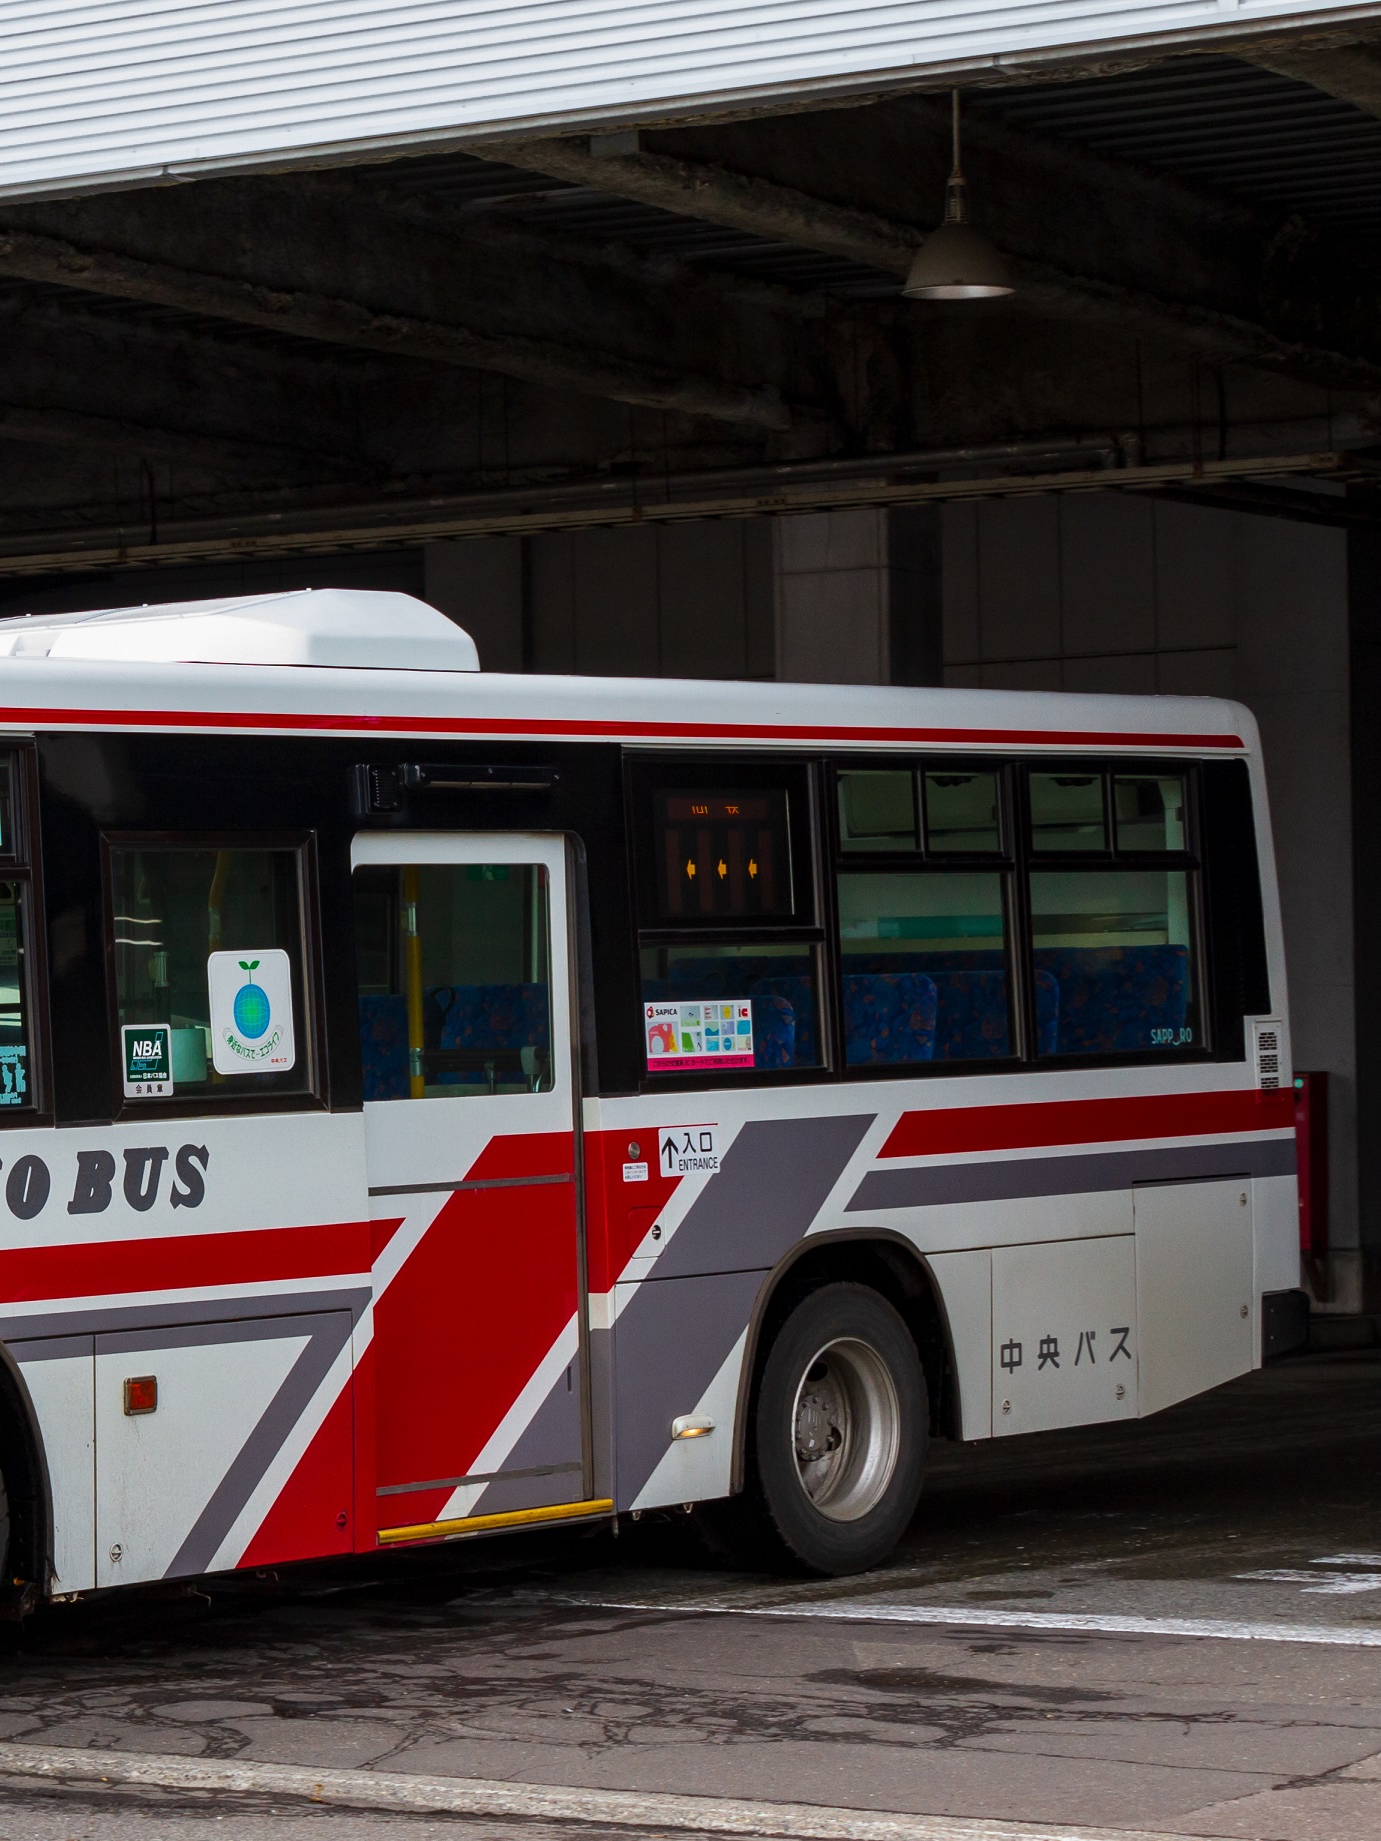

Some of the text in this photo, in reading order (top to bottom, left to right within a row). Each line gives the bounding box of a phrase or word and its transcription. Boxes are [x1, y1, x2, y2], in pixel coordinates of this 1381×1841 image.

[655, 1008, 678, 1016] SAPICA
[133, 1040, 162, 1056] NBA
[683, 1132, 712, 1154] 入口
[679, 1157, 718, 1171] ENTRANCE
[67, 1143, 210, 1215] BUS
[1000, 1327, 1132, 1374] 中央バス
